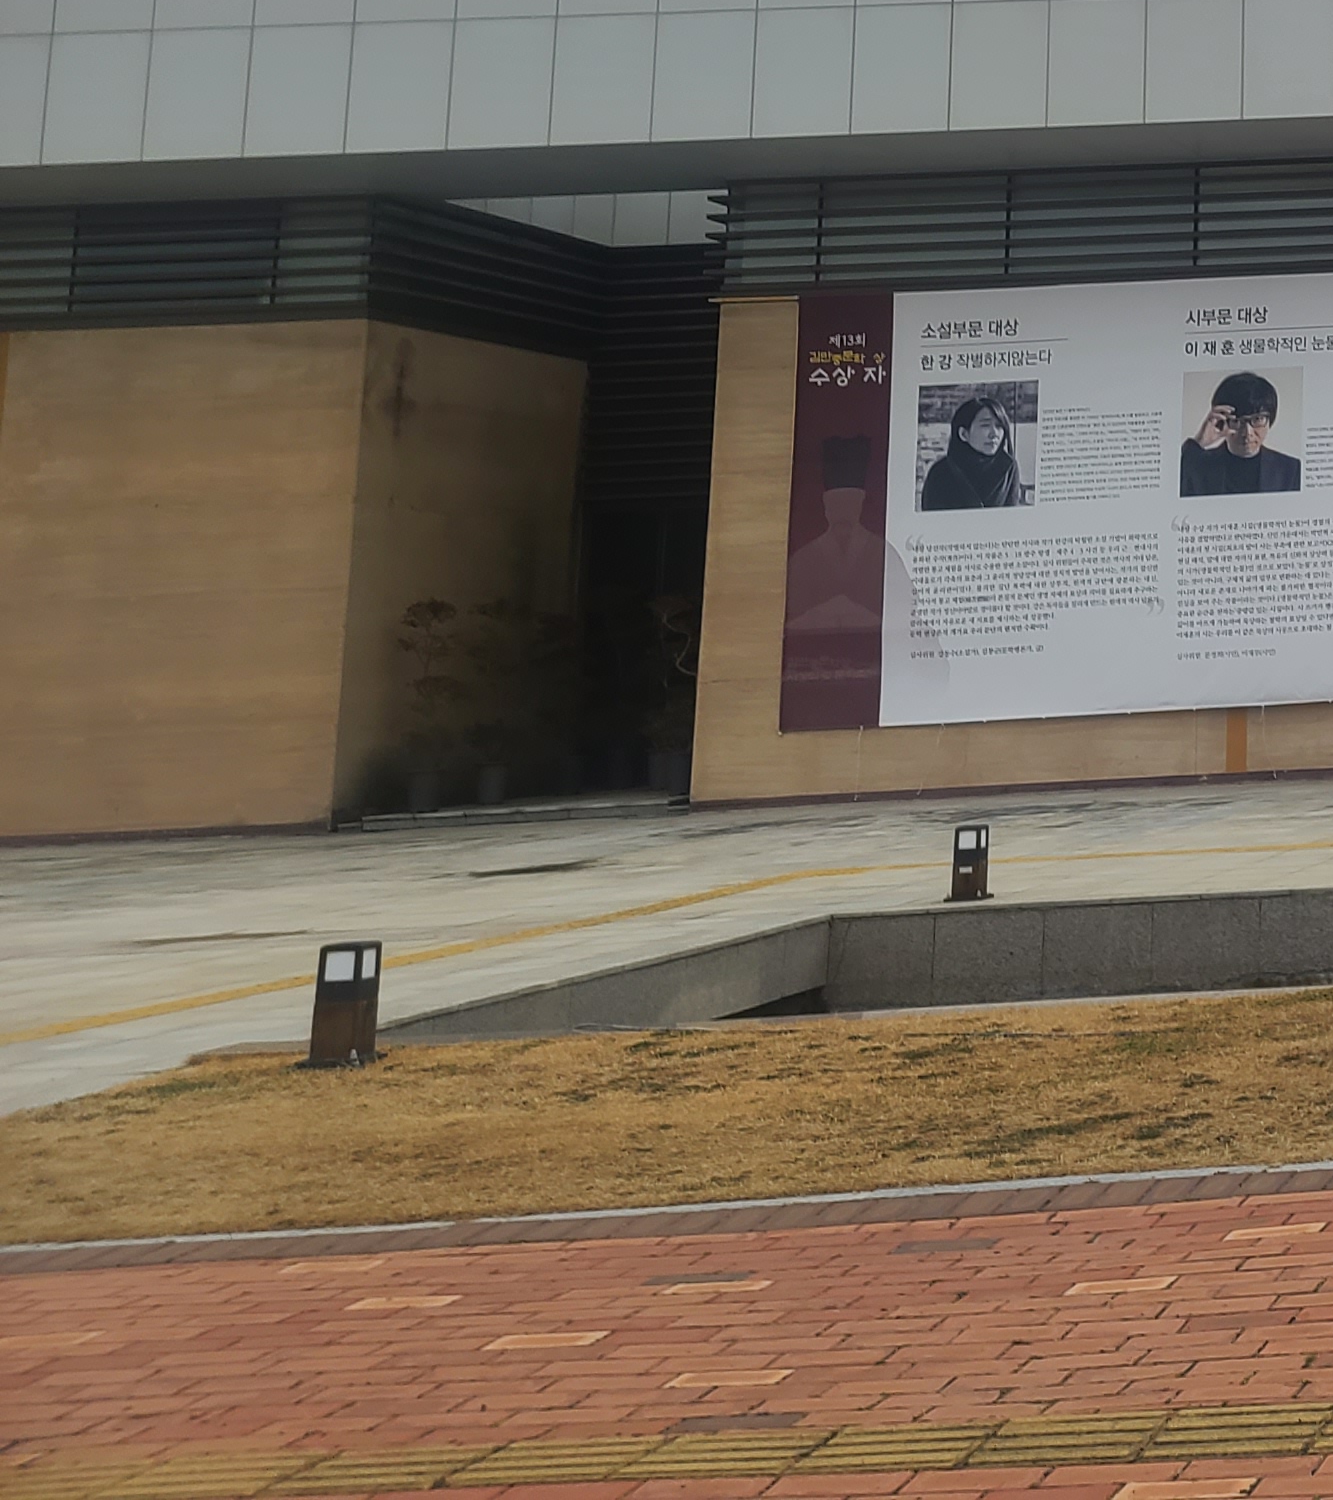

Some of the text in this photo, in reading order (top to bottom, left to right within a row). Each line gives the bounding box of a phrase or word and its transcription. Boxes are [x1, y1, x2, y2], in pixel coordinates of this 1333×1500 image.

[1185, 306, 1269, 327] 시부문 대상
[920, 318, 1019, 340] 소설부문 대상
[828, 332, 866, 349] 제13회
[1239, 336, 1307, 355] 생물학적인
